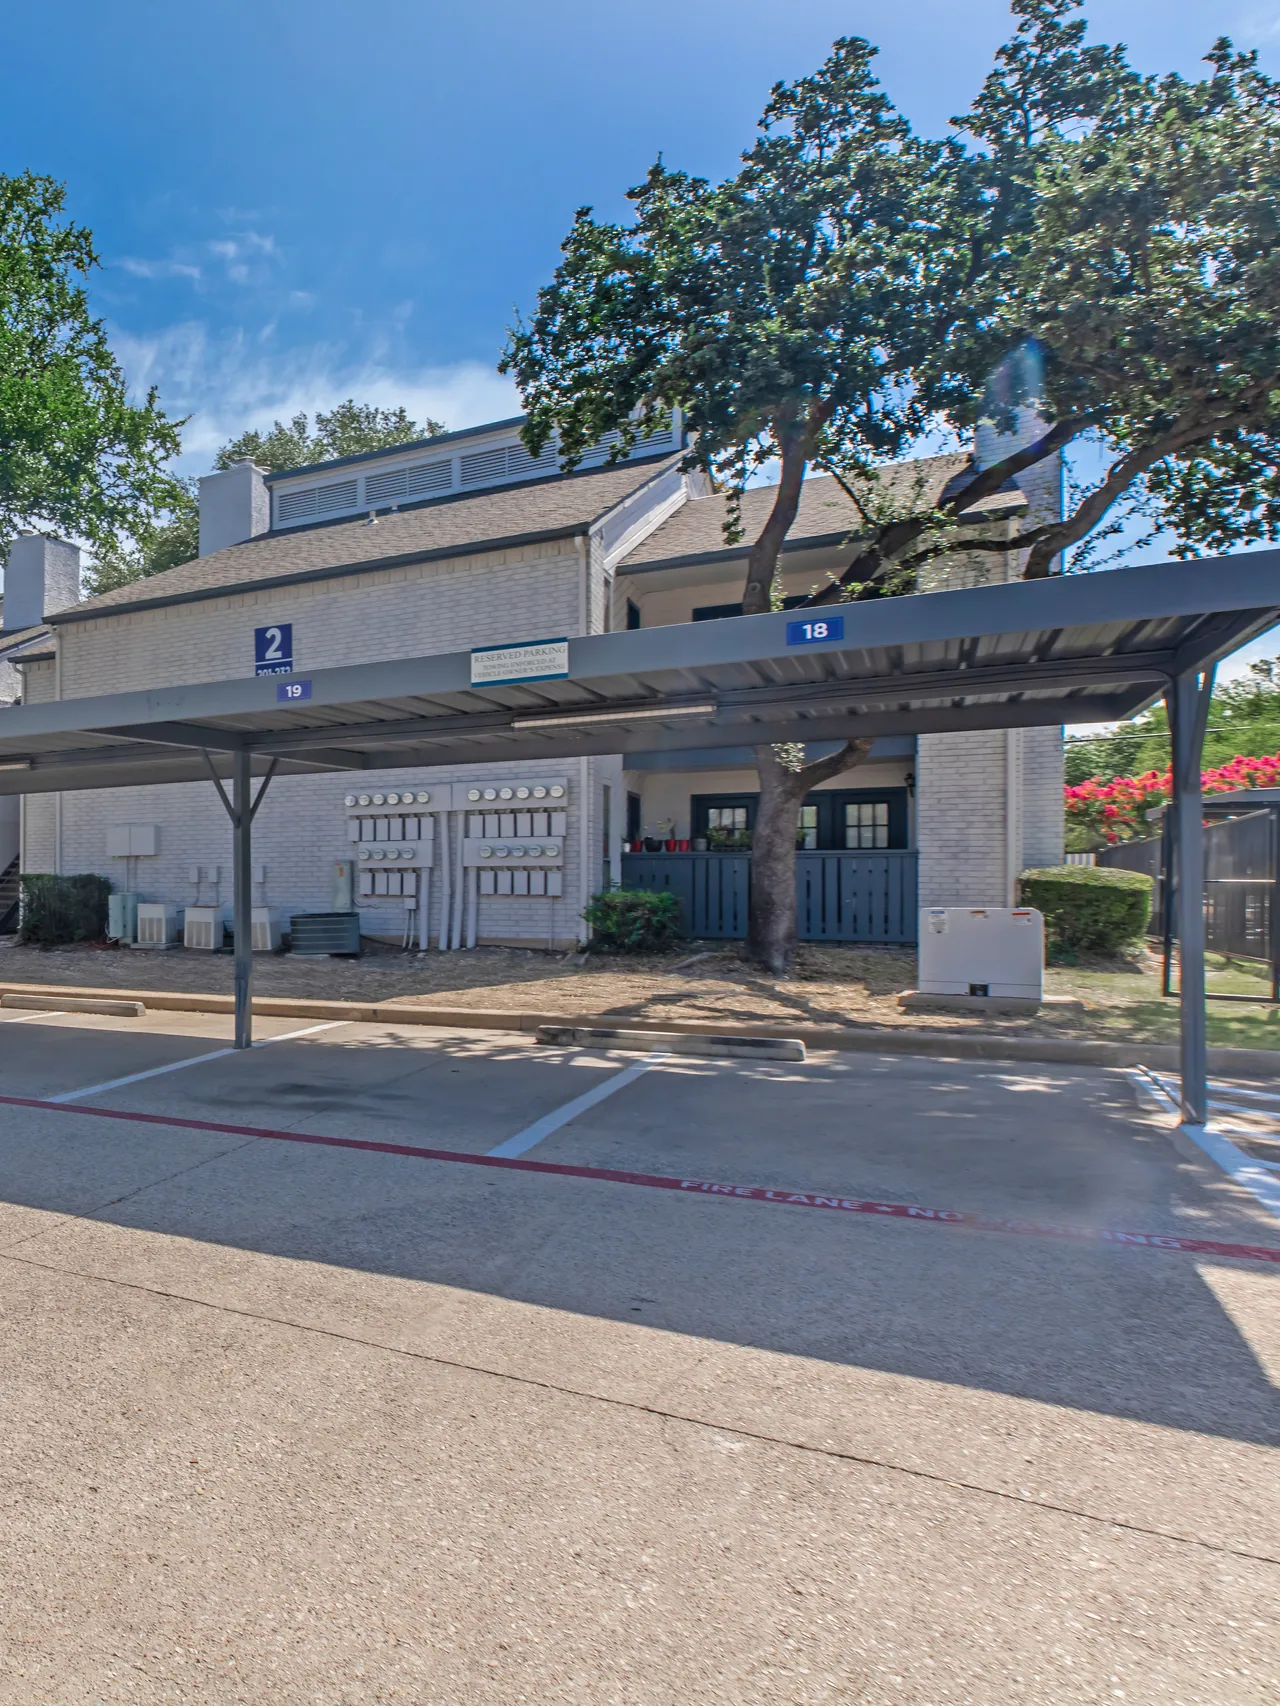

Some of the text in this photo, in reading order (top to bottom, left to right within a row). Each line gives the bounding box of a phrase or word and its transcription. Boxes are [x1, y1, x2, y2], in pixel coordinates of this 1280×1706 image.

[802, 622, 829, 639] 18
[265, 627, 282, 660] 2
[474, 646, 565, 663] RESERVED PARKING
[511, 659, 546, 668] ENFORCED
[286, 684, 302, 698] 19
[680, 1180, 753, 1196] FIRE
[766, 1190, 862, 1210] LANE
[907, 1207, 962, 1220] NO
